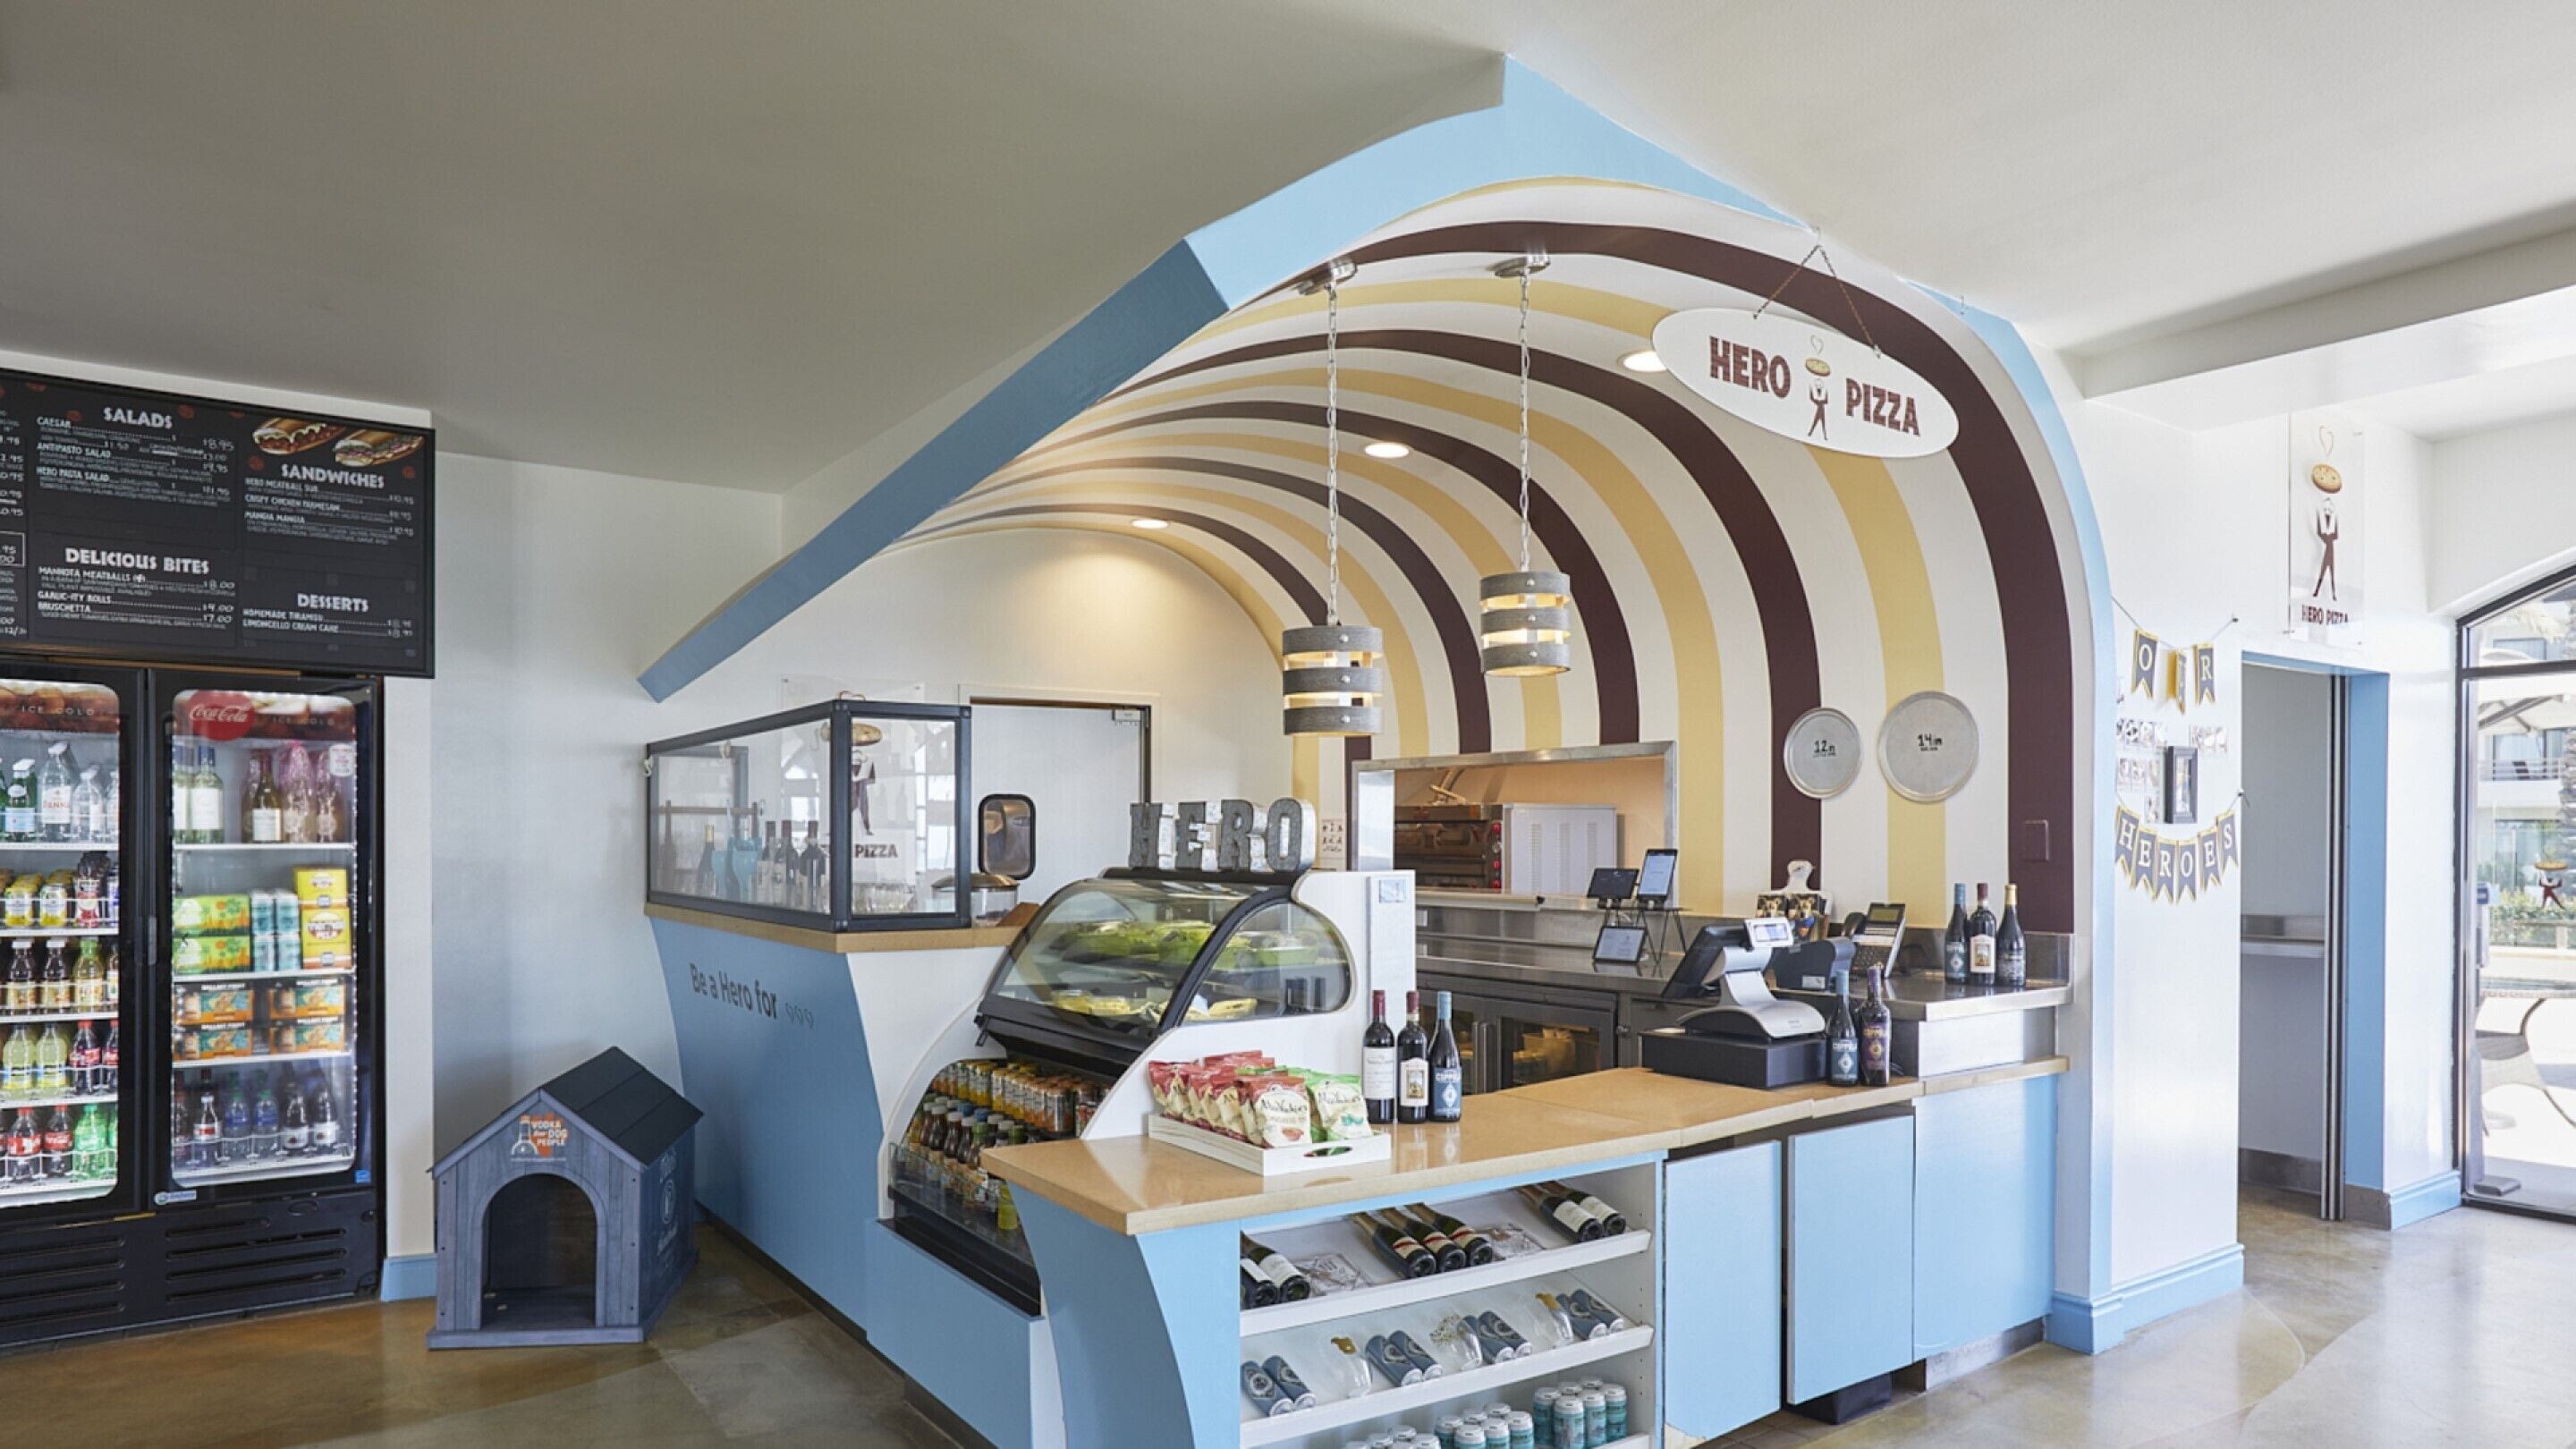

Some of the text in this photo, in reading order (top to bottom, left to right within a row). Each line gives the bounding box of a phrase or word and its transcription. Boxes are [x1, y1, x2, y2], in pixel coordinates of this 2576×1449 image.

[1709, 335, 1920, 436] HERO PIZZA
[37, 416, 72, 428] CAESAR
[103, 407, 173, 429] SALADS
[37, 442, 83, 455] ANTIPASTO
[85, 448, 112, 459] SALAD
[36, 466, 57, 478] HERO
[84, 471, 110, 482] SALAD
[281, 463, 385, 489] SANDWICHES
[270, 496, 301, 508] CHICKEN
[64, 547, 210, 575] DELICIOUS BITES
[82, 569, 131, 581] MEATBALLS
[37, 600, 90, 613] BRUSCHETTA
[297, 592, 369, 613] DESSERTS
[242, 608, 287, 620] HOMEMADE
[288, 611, 324, 622] TIRAMISU
[2301, 605, 2349, 625] HERO PIZZA
[242, 619, 291, 630] LIMONCELLO
[292, 622, 318, 631] CREAM
[21, 705, 95, 716] ICE COLD
[1128, 797, 1313, 873] HERO
[854, 843, 899, 859] PIZZA
[2118, 818, 2233, 878] HEROES
[689, 962, 778, 1021] Be a Hero for
[530, 1119, 562, 1130] VODKA
[548, 1128, 569, 1140] DOG
[537, 1138, 565, 1147] PEOPLE
